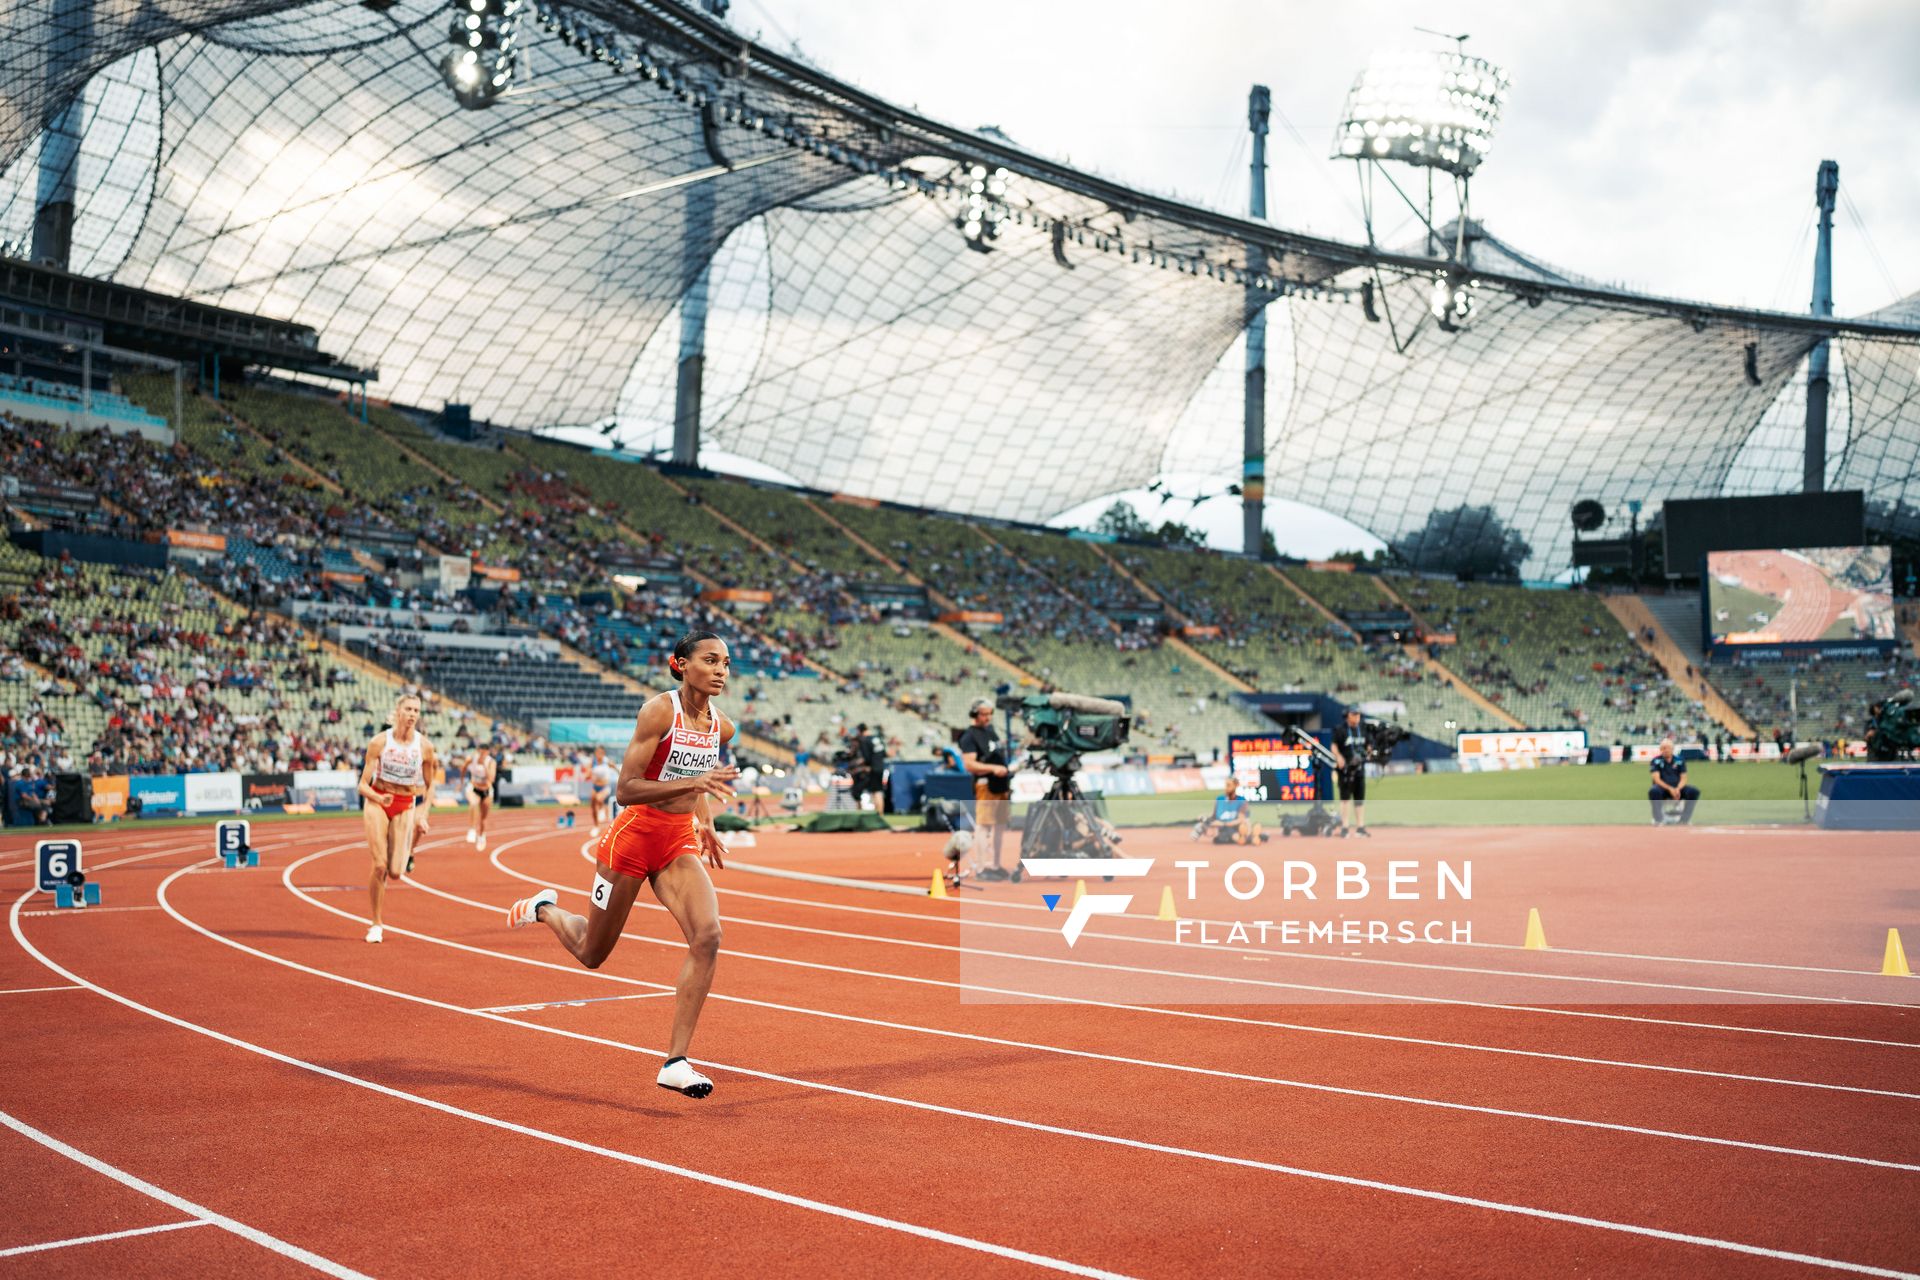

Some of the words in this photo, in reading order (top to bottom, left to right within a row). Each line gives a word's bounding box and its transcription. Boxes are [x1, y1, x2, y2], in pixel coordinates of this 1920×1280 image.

[675, 731, 714, 747] SPAR
[668, 750, 717, 769] RICHARD
[226, 830, 240, 850] 5
[48, 853, 69, 878] 6
[595, 883, 605, 901] 6
